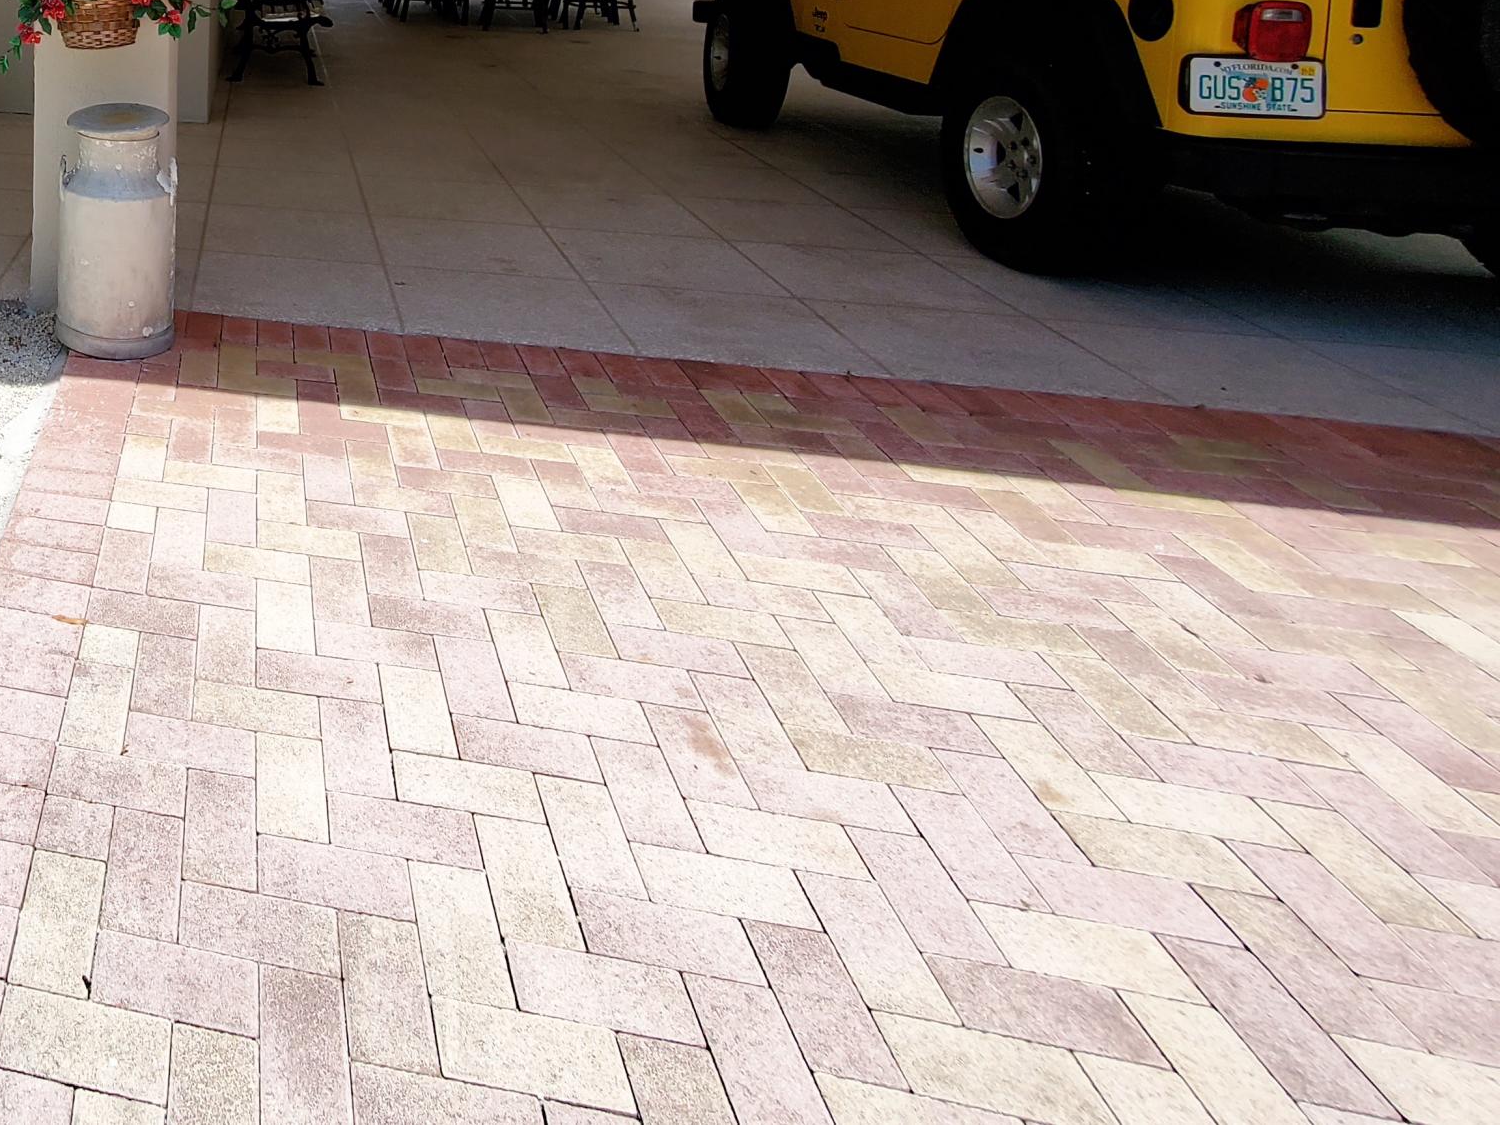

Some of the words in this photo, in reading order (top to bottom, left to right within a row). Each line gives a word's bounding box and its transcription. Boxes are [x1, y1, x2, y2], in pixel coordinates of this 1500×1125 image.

[1200, 74, 1241, 100] GUS
[1271, 77, 1315, 103] B75
[1220, 101, 1261, 111] SUNSHINE
[1266, 102, 1293, 112] STATE
